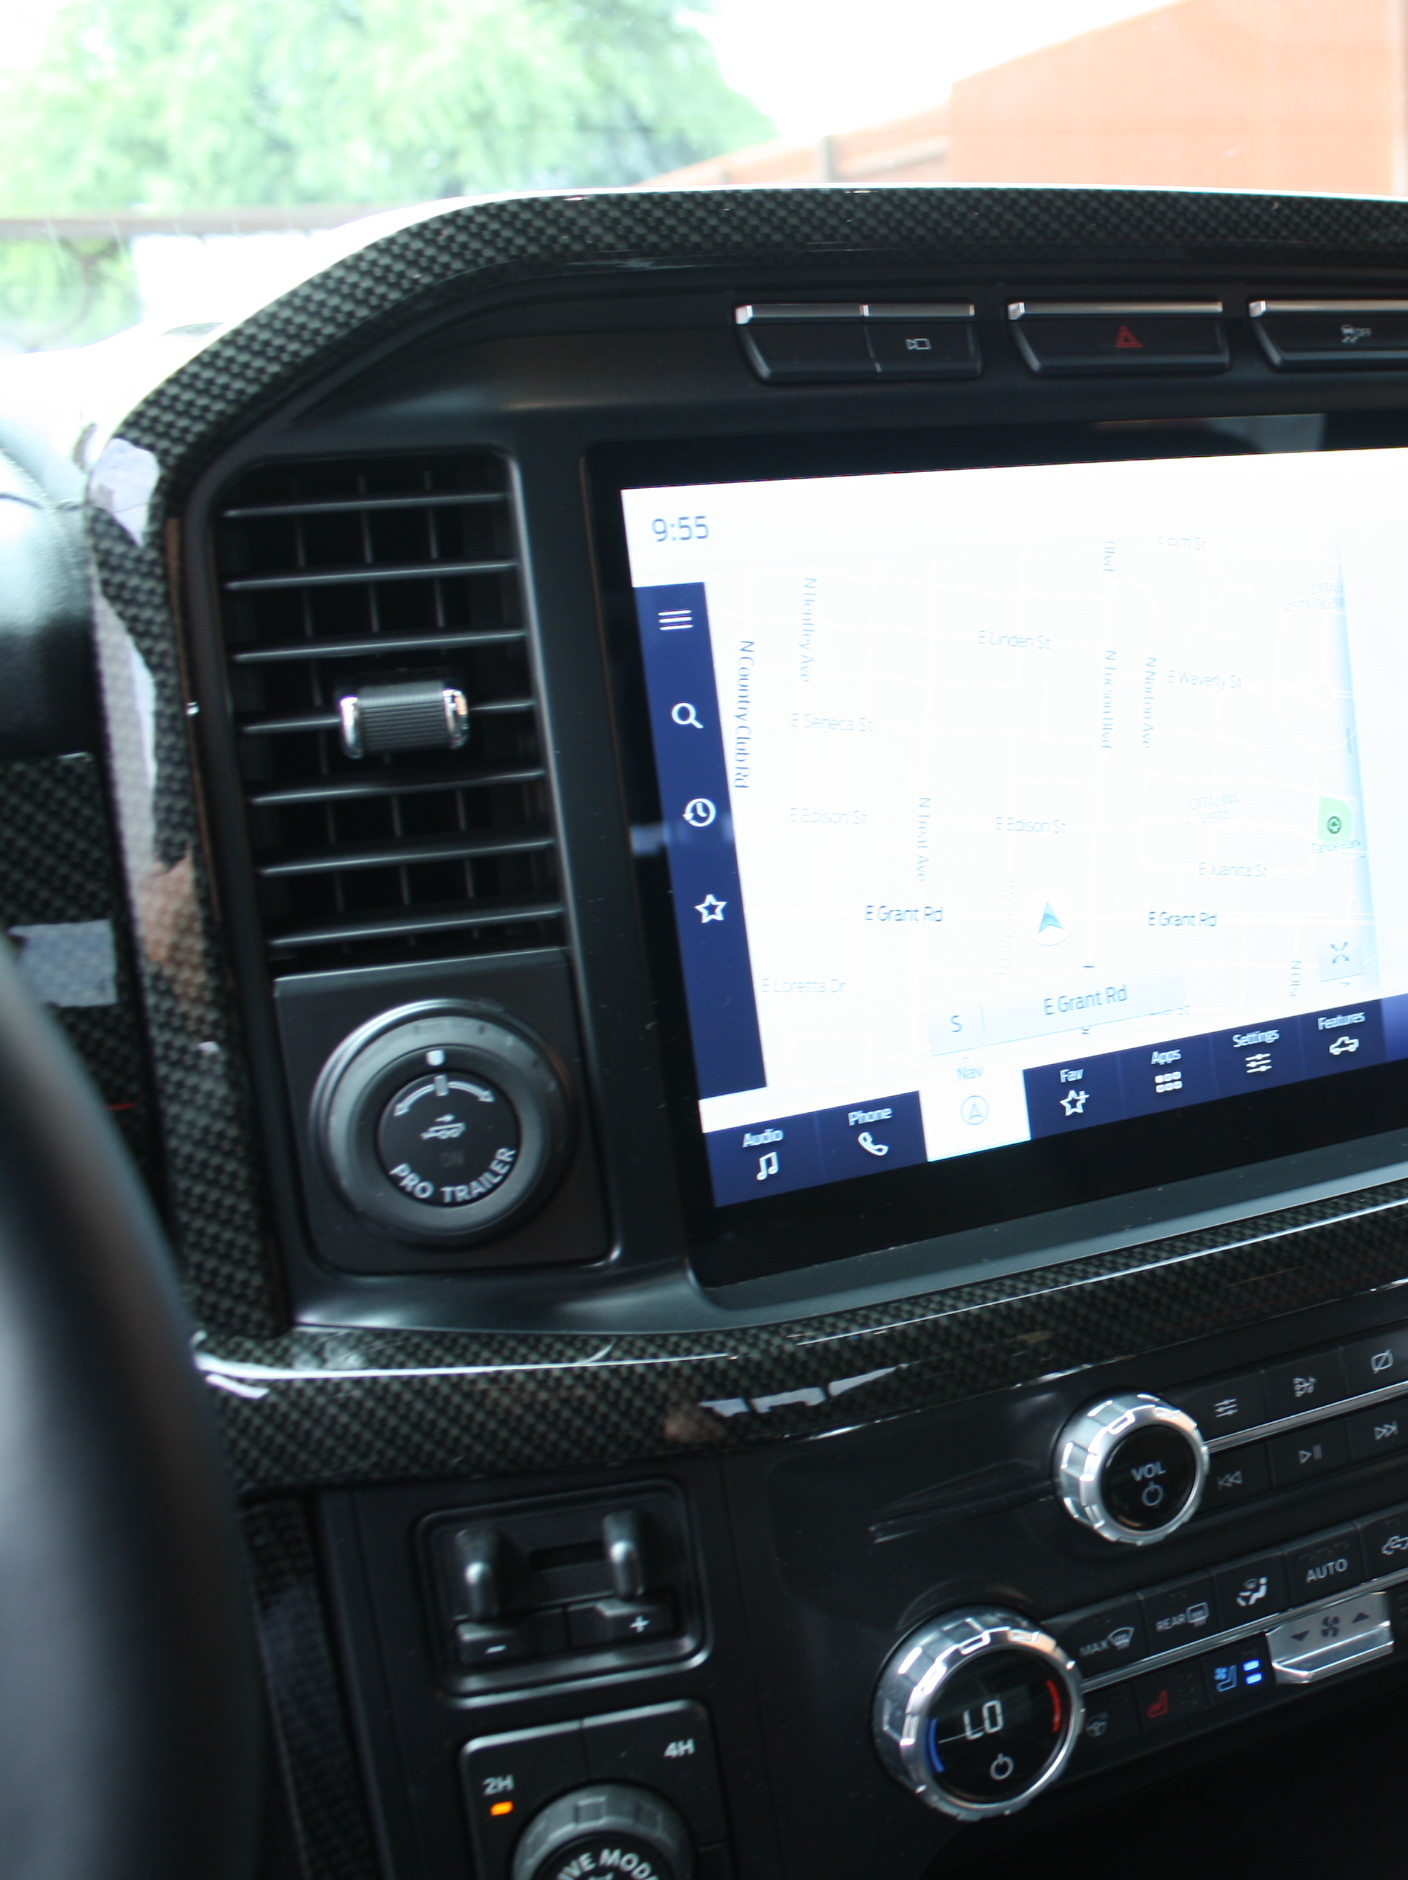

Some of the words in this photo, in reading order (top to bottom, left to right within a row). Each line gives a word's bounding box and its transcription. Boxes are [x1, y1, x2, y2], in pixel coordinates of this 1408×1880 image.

[651, 514, 711, 544] 9:55
[739, 640, 755, 652] N
[977, 629, 986, 645] E
[988, 630, 1035, 648] Linden
[1104, 650, 1118, 661] N
[1145, 657, 1157, 668] N
[734, 656, 755, 721] Country
[734, 725, 752, 763] Club
[734, 766, 751, 788] Rd
[864, 905, 875, 920] E
[877, 905, 920, 922] Grant
[923, 906, 944, 922] Rd
[1147, 911, 1157, 926] E
[1158, 911, 1197, 927] Grant
[1199, 911, 1218, 928] Rd
[1044, 998, 1056, 1016] E
[1057, 988, 1103, 1014] Grant
[1104, 983, 1128, 1006] Rd
[949, 1013, 964, 1034] S
[1317, 1010, 1366, 1031] Features
[1232, 1028, 1280, 1049] Settings
[1151, 1047, 1182, 1066] Apps
[1060, 1067, 1084, 1084] Fav
[848, 1106, 892, 1127] Phone
[742, 1127, 784, 1148] Audio
[389, 1162, 435, 1199] PRO
[439, 1146, 517, 1204] TRAILER
[1130, 1460, 1168, 1481] VOL
[1305, 1556, 1348, 1583] AUTO
[1155, 1612, 1187, 1632] REAR
[663, 1738, 696, 1759] 4H
[482, 1774, 515, 1796] 2H
[557, 1851, 597, 1880] IVE
